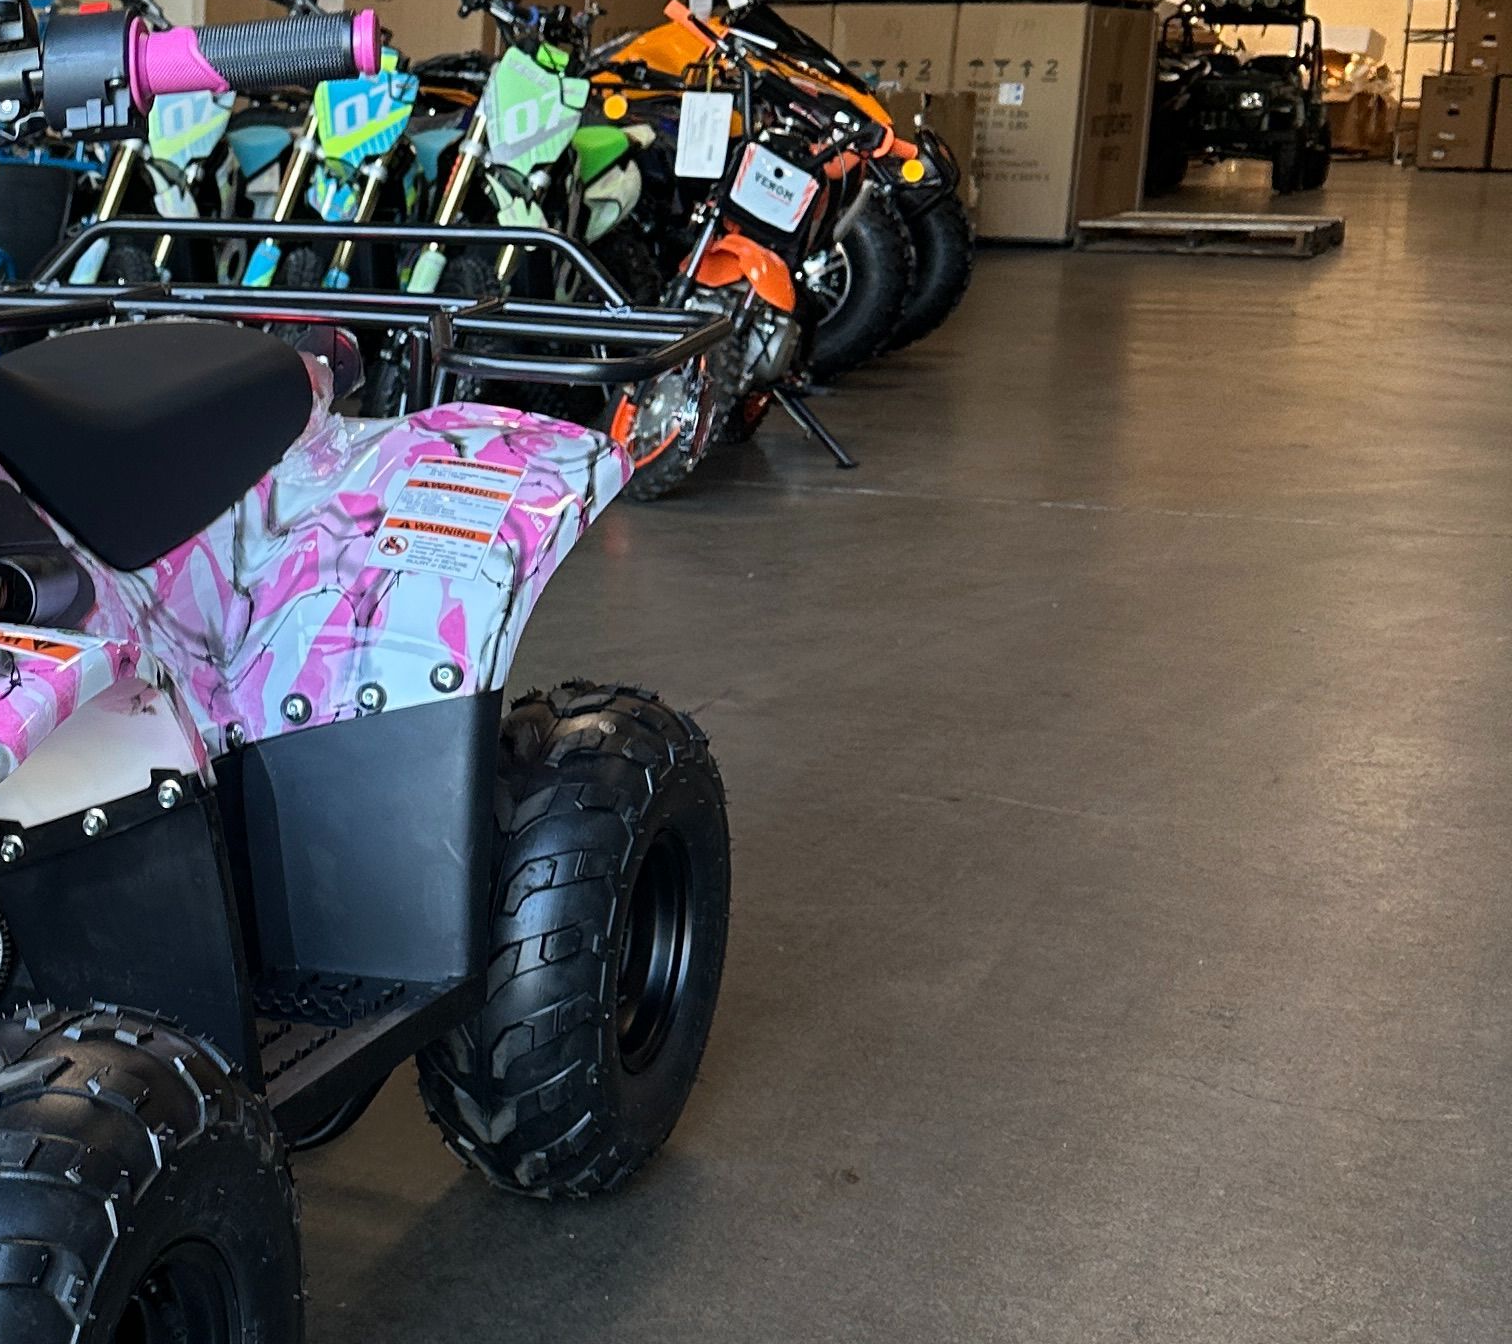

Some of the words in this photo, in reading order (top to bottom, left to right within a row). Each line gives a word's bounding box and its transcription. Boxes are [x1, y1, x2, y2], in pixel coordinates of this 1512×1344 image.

[919, 58, 932, 76] 2
[1044, 57, 1058, 76] 2
[335, 84, 393, 136] 07
[503, 94, 564, 146] 07
[754, 171, 795, 202] VENOM
[431, 482, 500, 499] WARNING
[414, 521, 477, 540] WARNING
